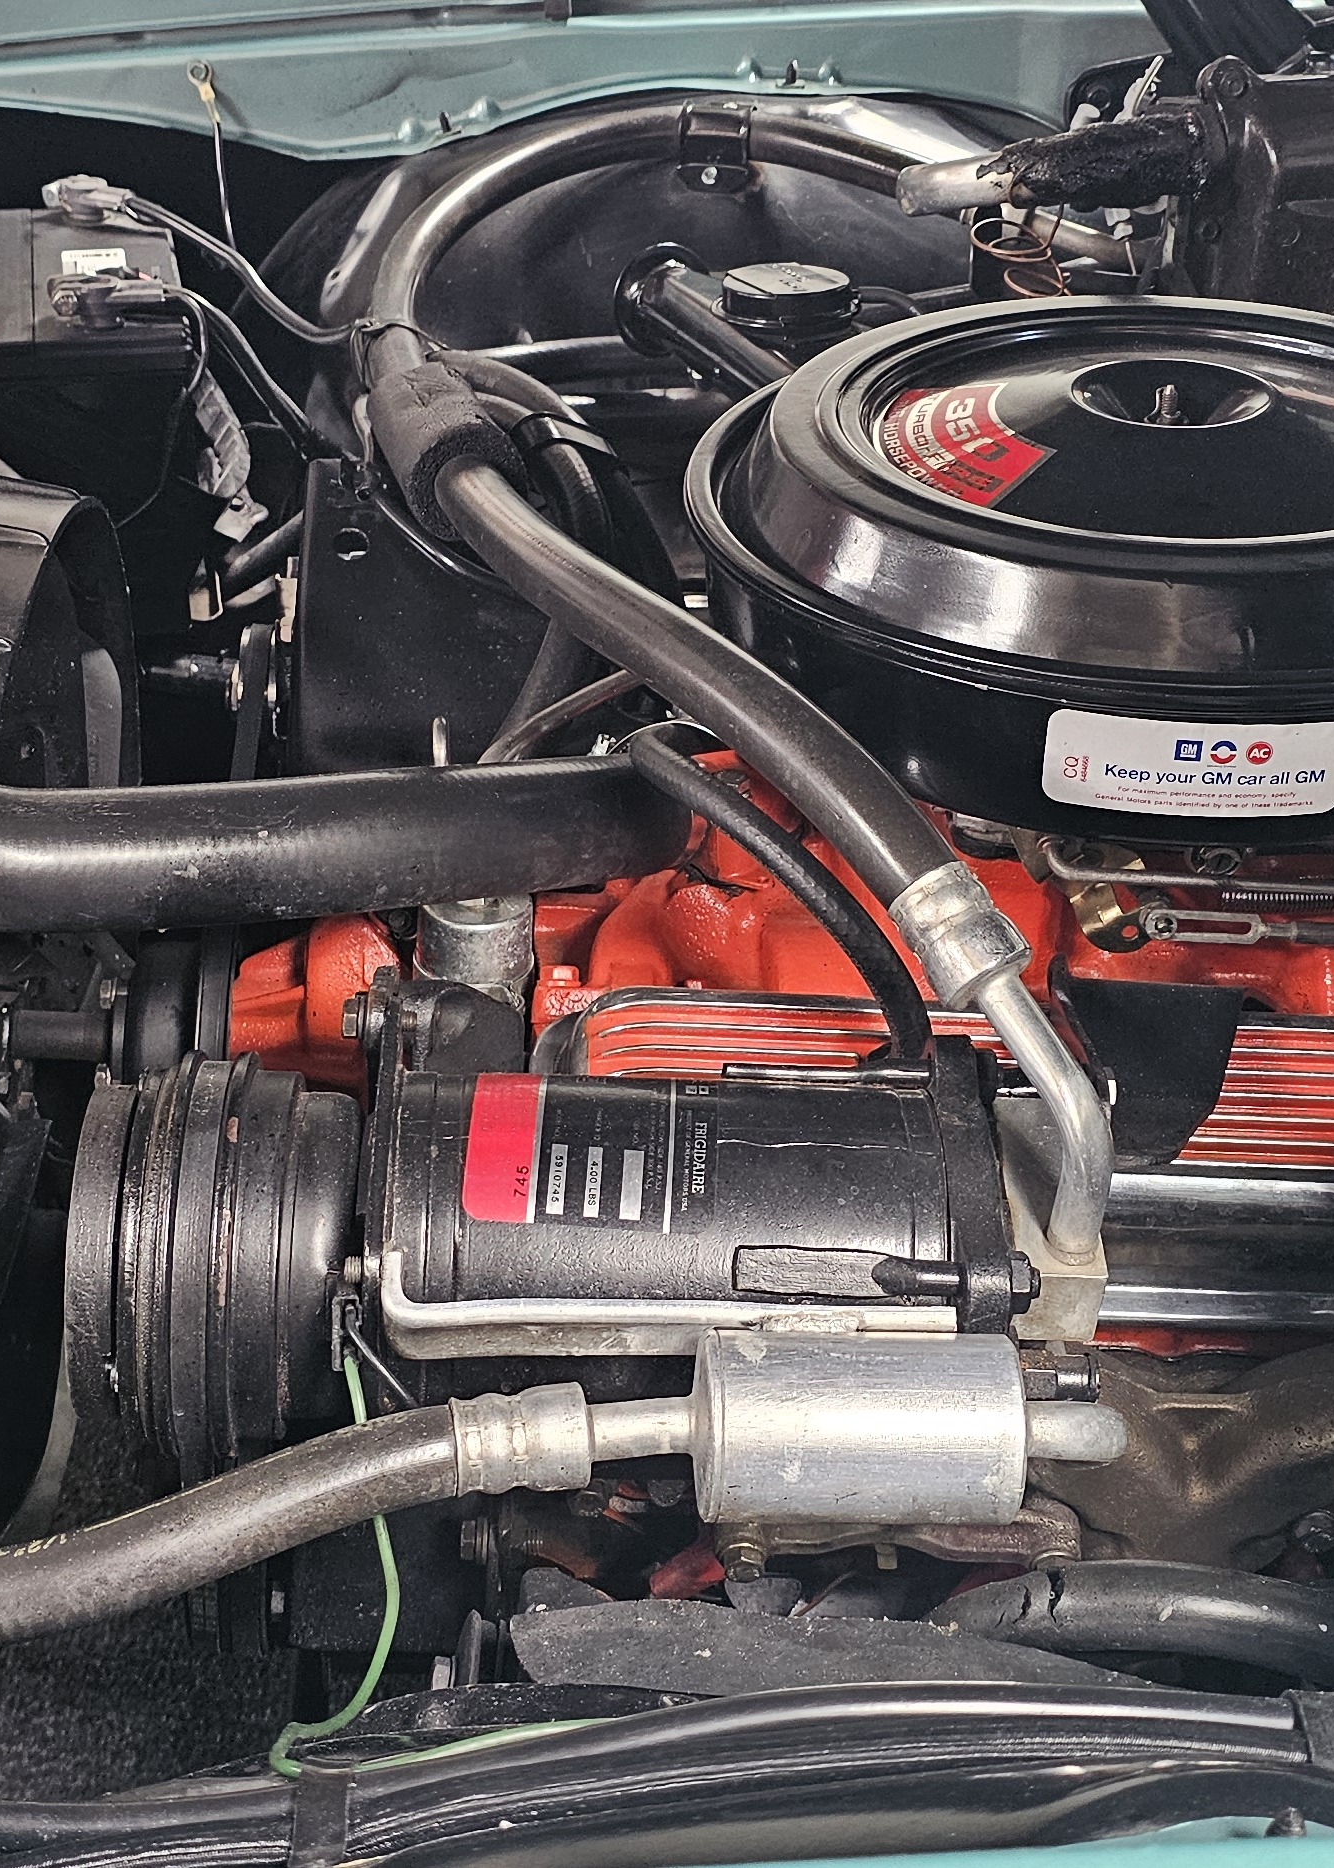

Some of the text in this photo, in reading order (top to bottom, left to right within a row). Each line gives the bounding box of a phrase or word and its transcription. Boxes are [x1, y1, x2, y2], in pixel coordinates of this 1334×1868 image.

[944, 397, 1010, 462] 350
[1180, 744, 1198, 757] GM
[1249, 748, 1270, 759] AC
[1063, 755, 1080, 778] CQ
[1104, 763, 1326, 785] Keep your GM car all GM
[1095, 793, 1124, 802] General
[1126, 796, 1152, 804] Motors
[1212, 801, 1222, 809] by
[1170, 791, 1216, 799] performance
[683, 1140, 692, 1167] GENERAL
[691, 1122, 708, 1194] FRIGIDAIRE
[513, 1165, 530, 1197] 745
[551, 1155, 564, 1203] 5910745
[587, 1160, 599, 1206] 4.00 LBS
[681, 1167, 690, 1196] MOTORS
[680, 1197, 688, 1212] USA
